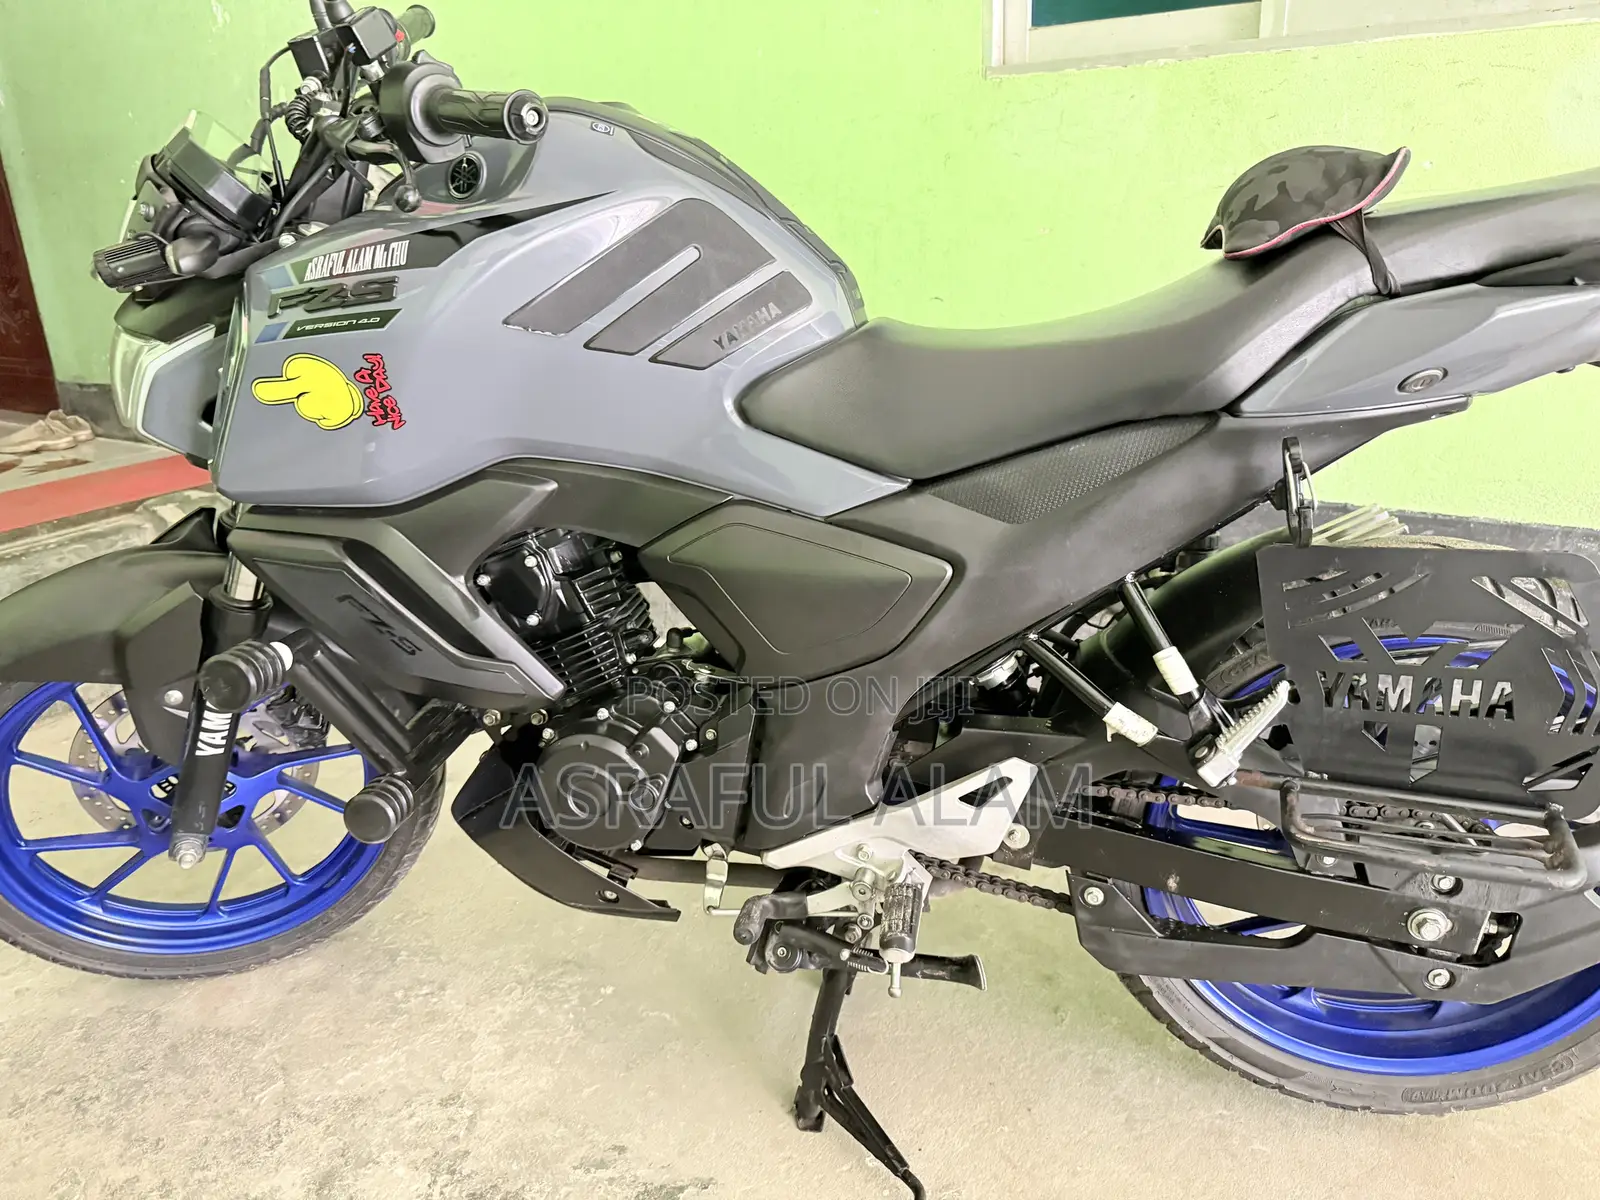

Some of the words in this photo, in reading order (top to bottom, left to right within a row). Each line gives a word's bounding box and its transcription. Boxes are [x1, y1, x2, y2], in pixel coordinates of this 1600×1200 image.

[345, 245, 375, 273] ALAM
[296, 319, 357, 332] VERSION
[357, 317, 381, 325] 4.0
[712, 301, 782, 351] YAMAHA
[1316, 670, 1515, 721] YAMAHA
